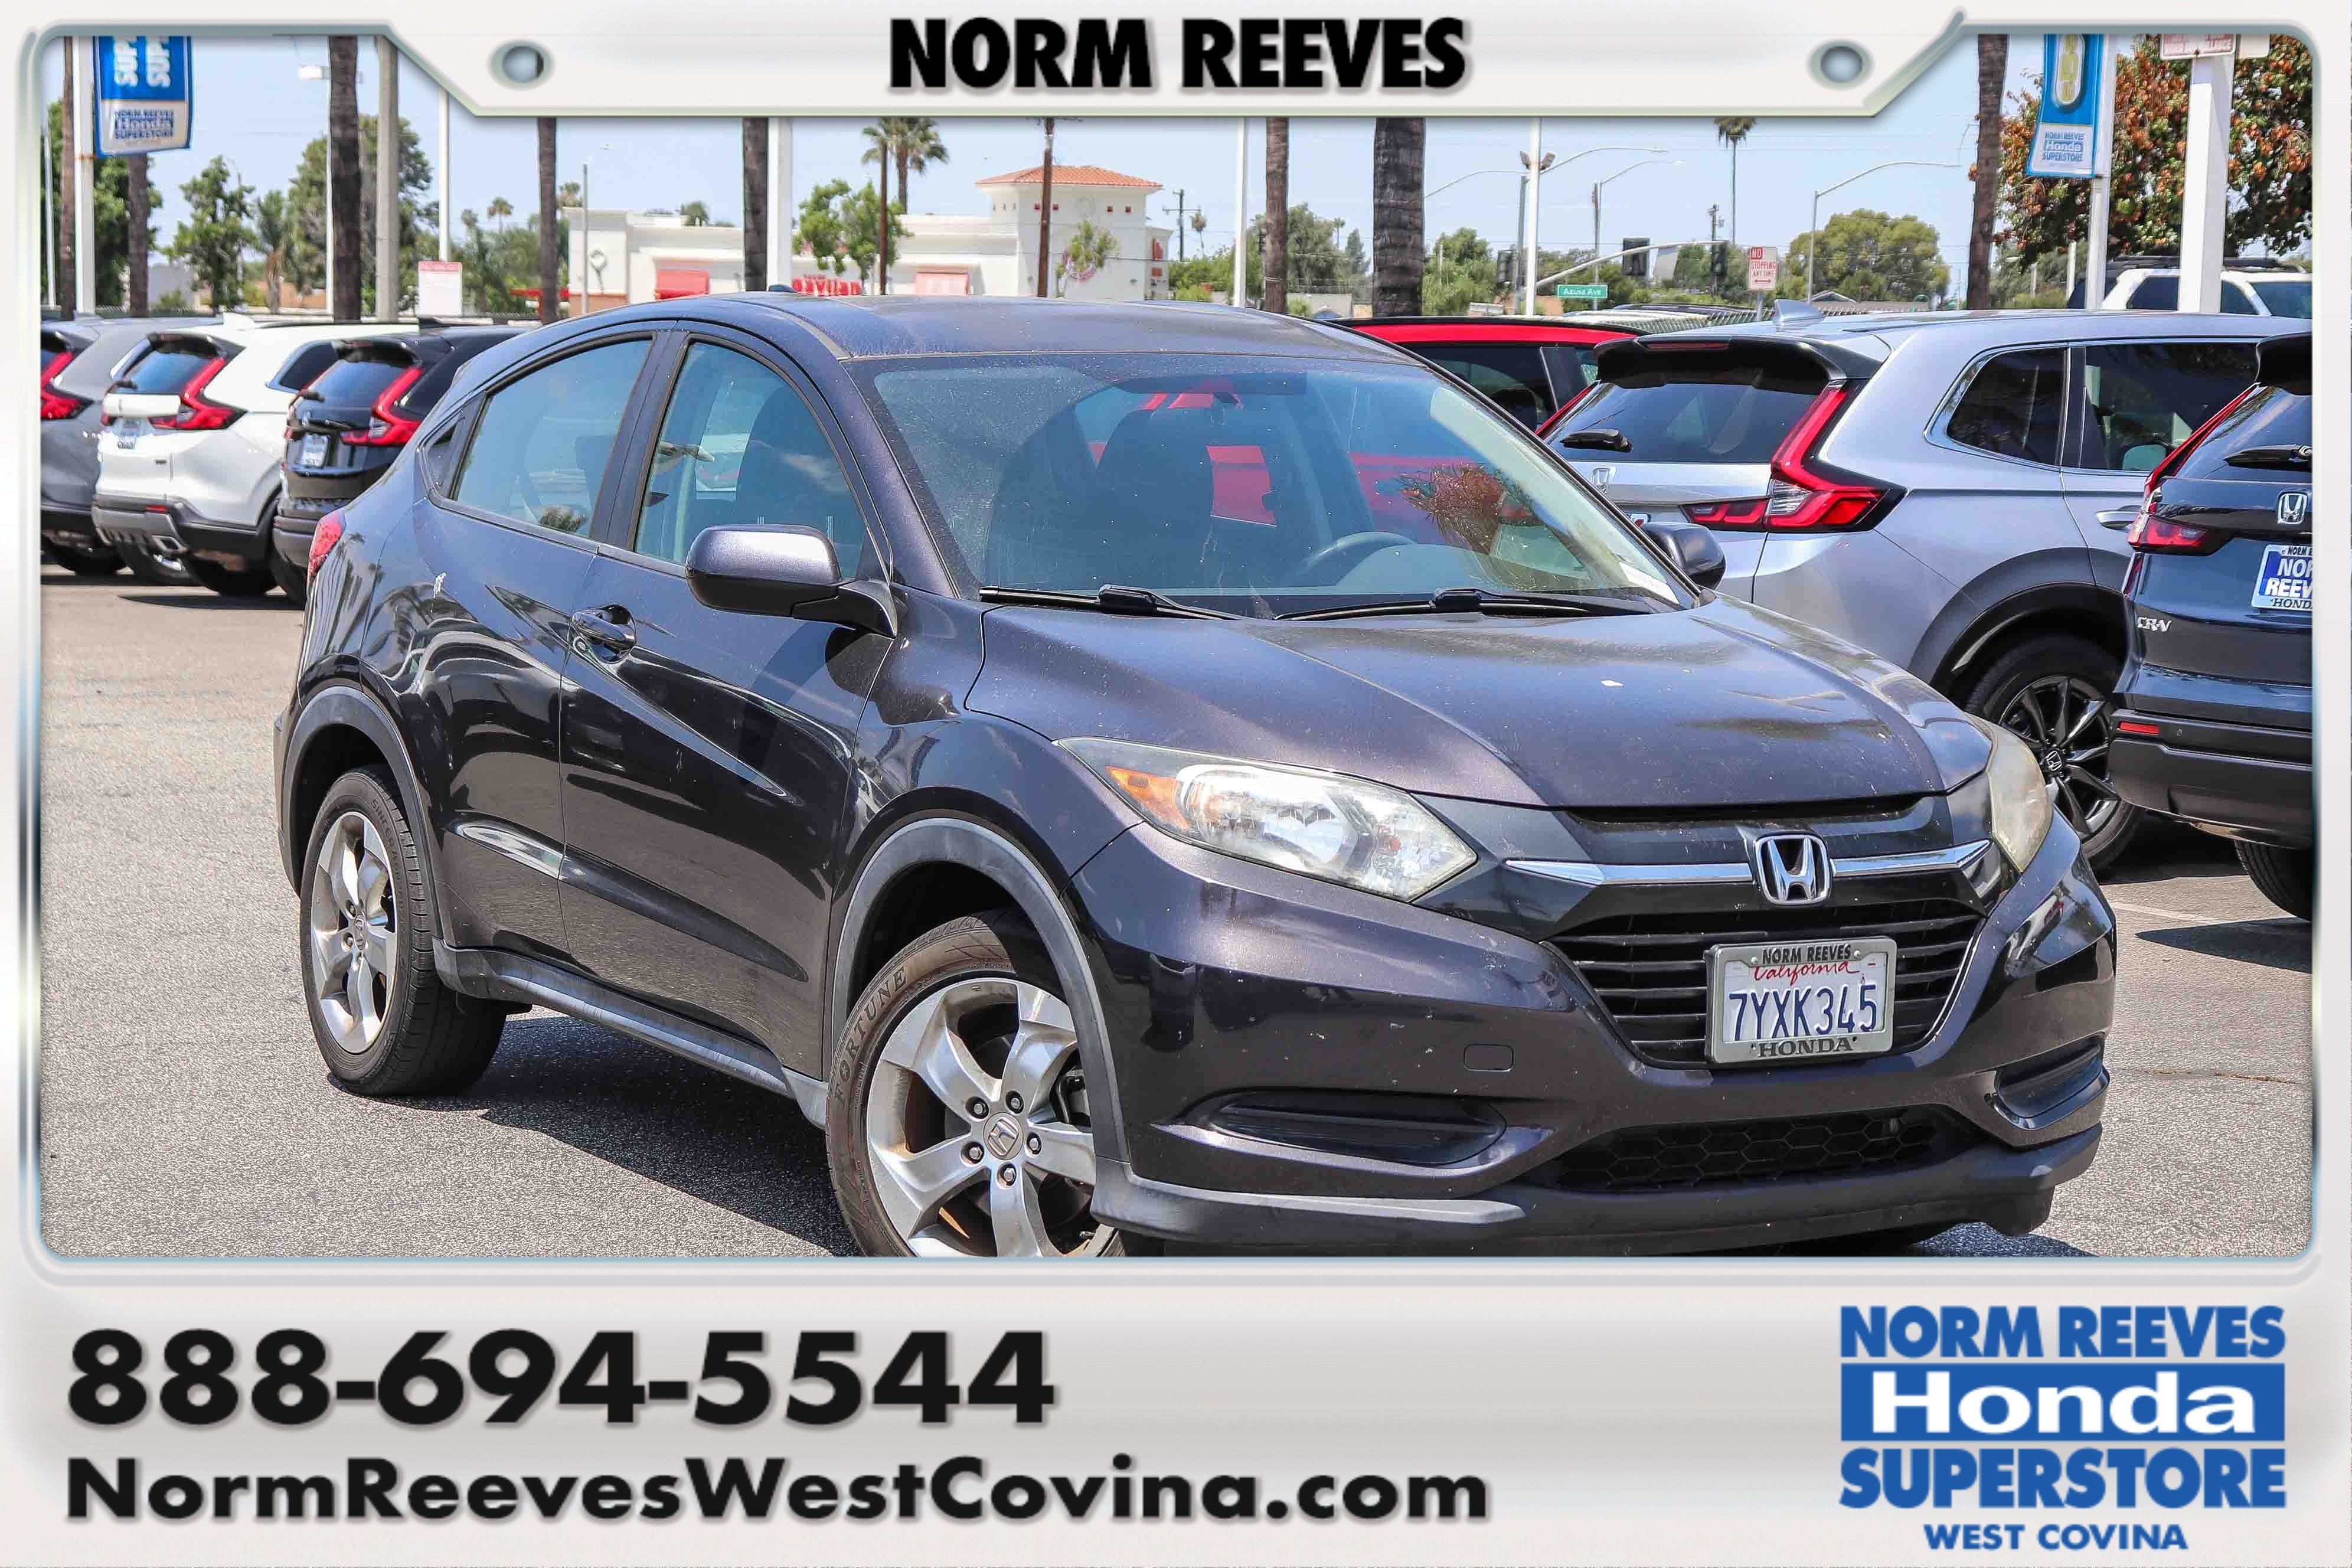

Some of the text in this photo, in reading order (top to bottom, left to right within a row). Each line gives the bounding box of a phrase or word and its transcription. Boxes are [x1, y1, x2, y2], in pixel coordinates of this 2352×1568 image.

[2045, 141, 2083, 152] Honda
[2042, 151, 2084, 162] SUPERSTORE
[1751, 247, 1762, 259] NO
[1750, 260, 1776, 270] STOPPING
[2287, 545, 2307, 556] NORM
[2271, 598, 2313, 609] HOND
[2137, 616, 2173, 632] CR-V
[1762, 945, 1851, 964] NORM REEVES
[1751, 961, 1860, 986] California
[1729, 984, 1877, 1042] 7YXK345
[834, 965, 907, 1105] FORTUNE
[1756, 1037, 1854, 1058] HONDA
